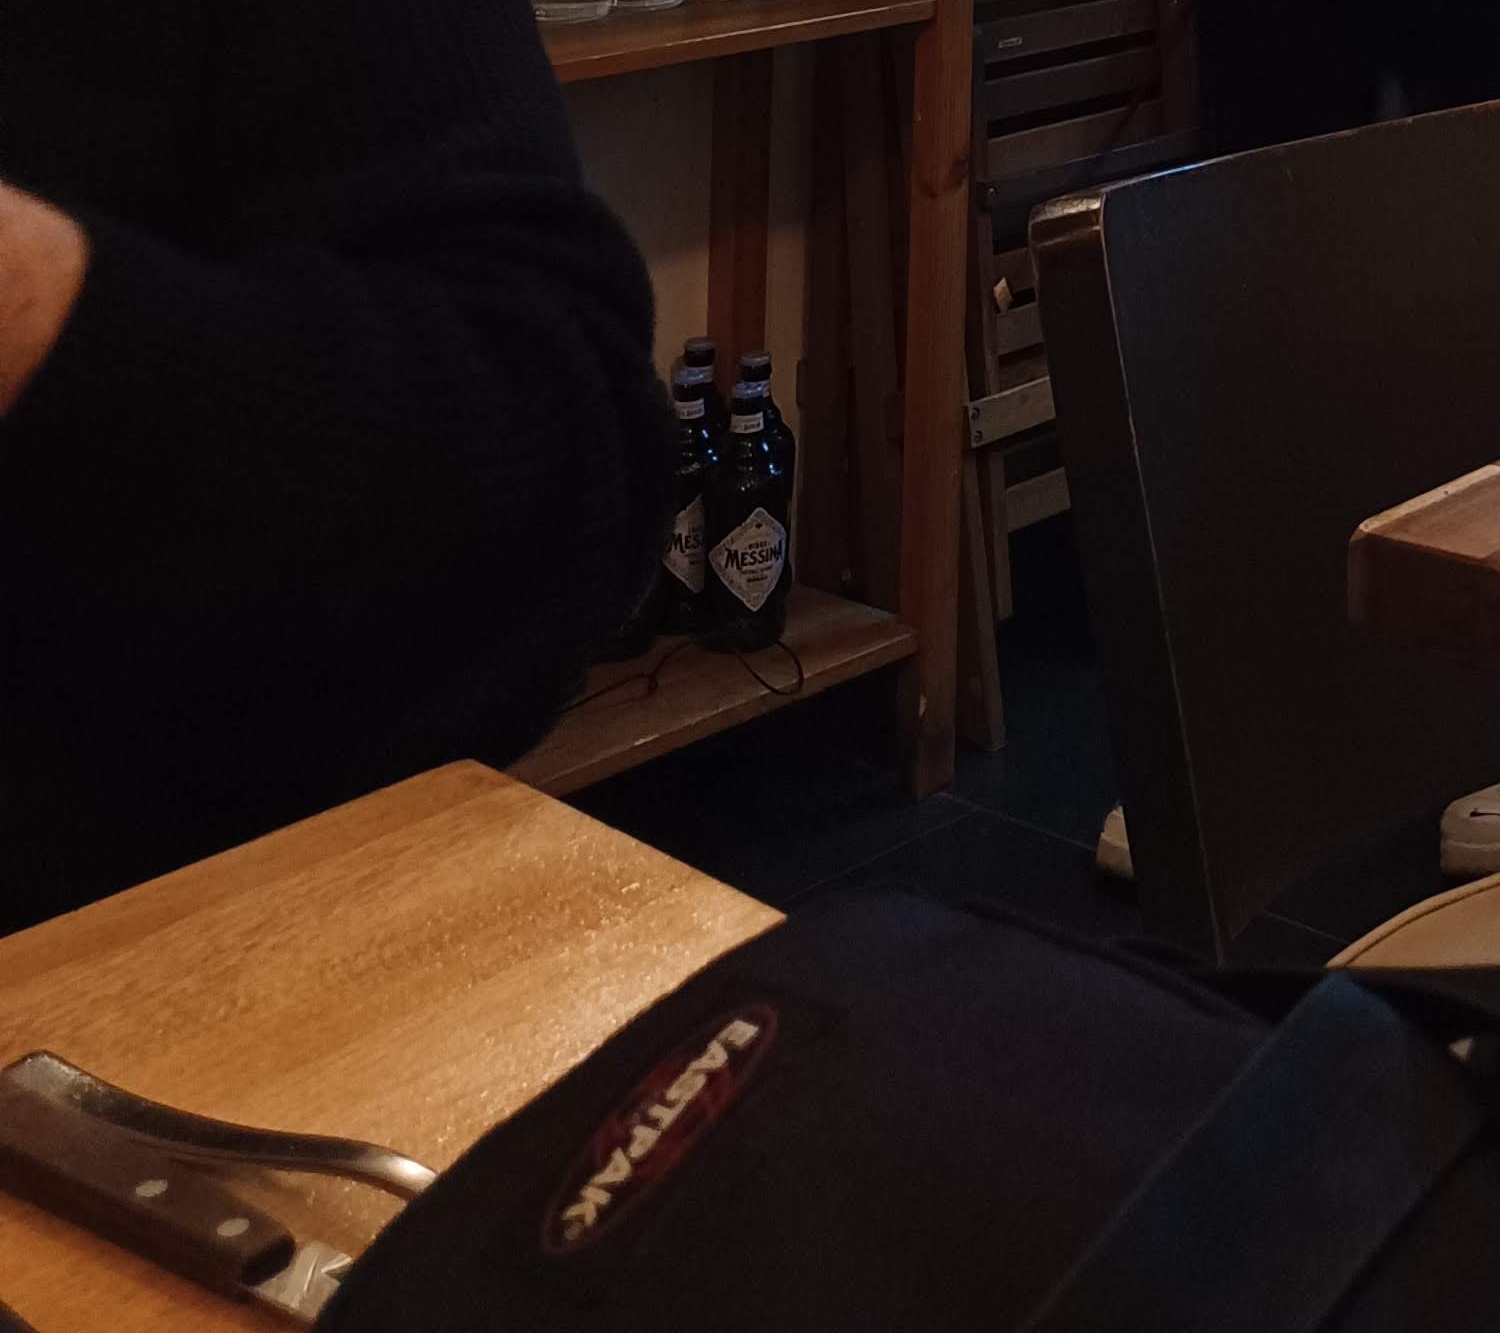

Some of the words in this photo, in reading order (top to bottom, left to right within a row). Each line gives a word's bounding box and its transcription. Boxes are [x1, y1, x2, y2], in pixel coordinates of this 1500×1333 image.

[667, 533, 702, 553] MES
[725, 539, 783, 570] MESSINA
[561, 1018, 760, 1241] EASTPAK
